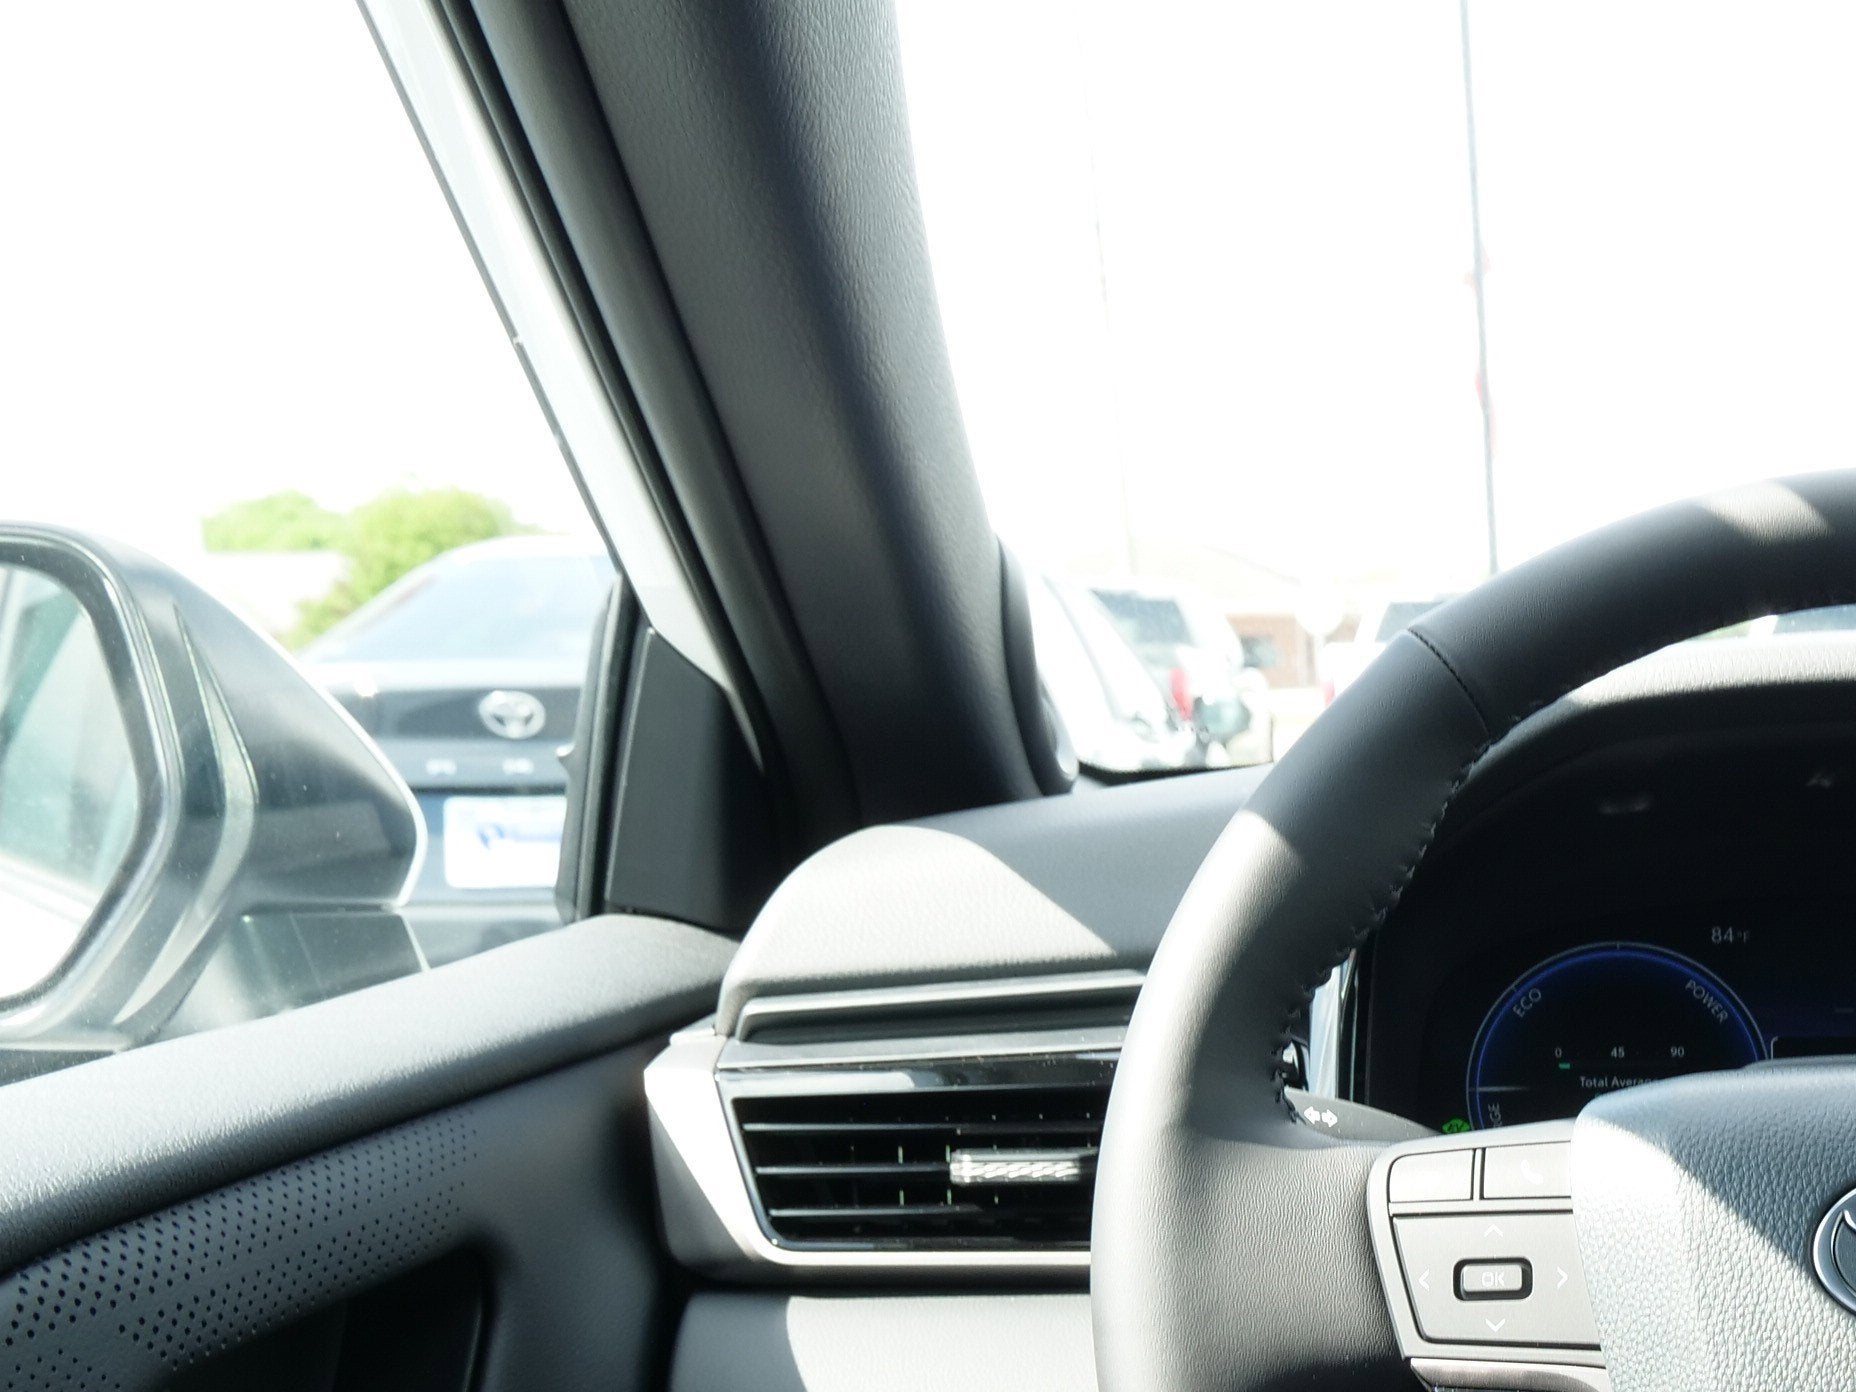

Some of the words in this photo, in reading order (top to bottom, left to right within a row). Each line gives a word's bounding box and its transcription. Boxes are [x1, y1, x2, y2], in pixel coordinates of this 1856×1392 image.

[1710, 925, 1734, 944] 84
[1511, 988, 1542, 1019] ECO
[1684, 979, 1729, 1025] POWER
[1554, 1047, 1562, 1059] 0
[1610, 1047, 1626, 1059] 45
[1670, 1047, 1685, 1059] 90
[1579, 1075, 1609, 1088] Total
[1480, 1270, 1505, 1288] OK
